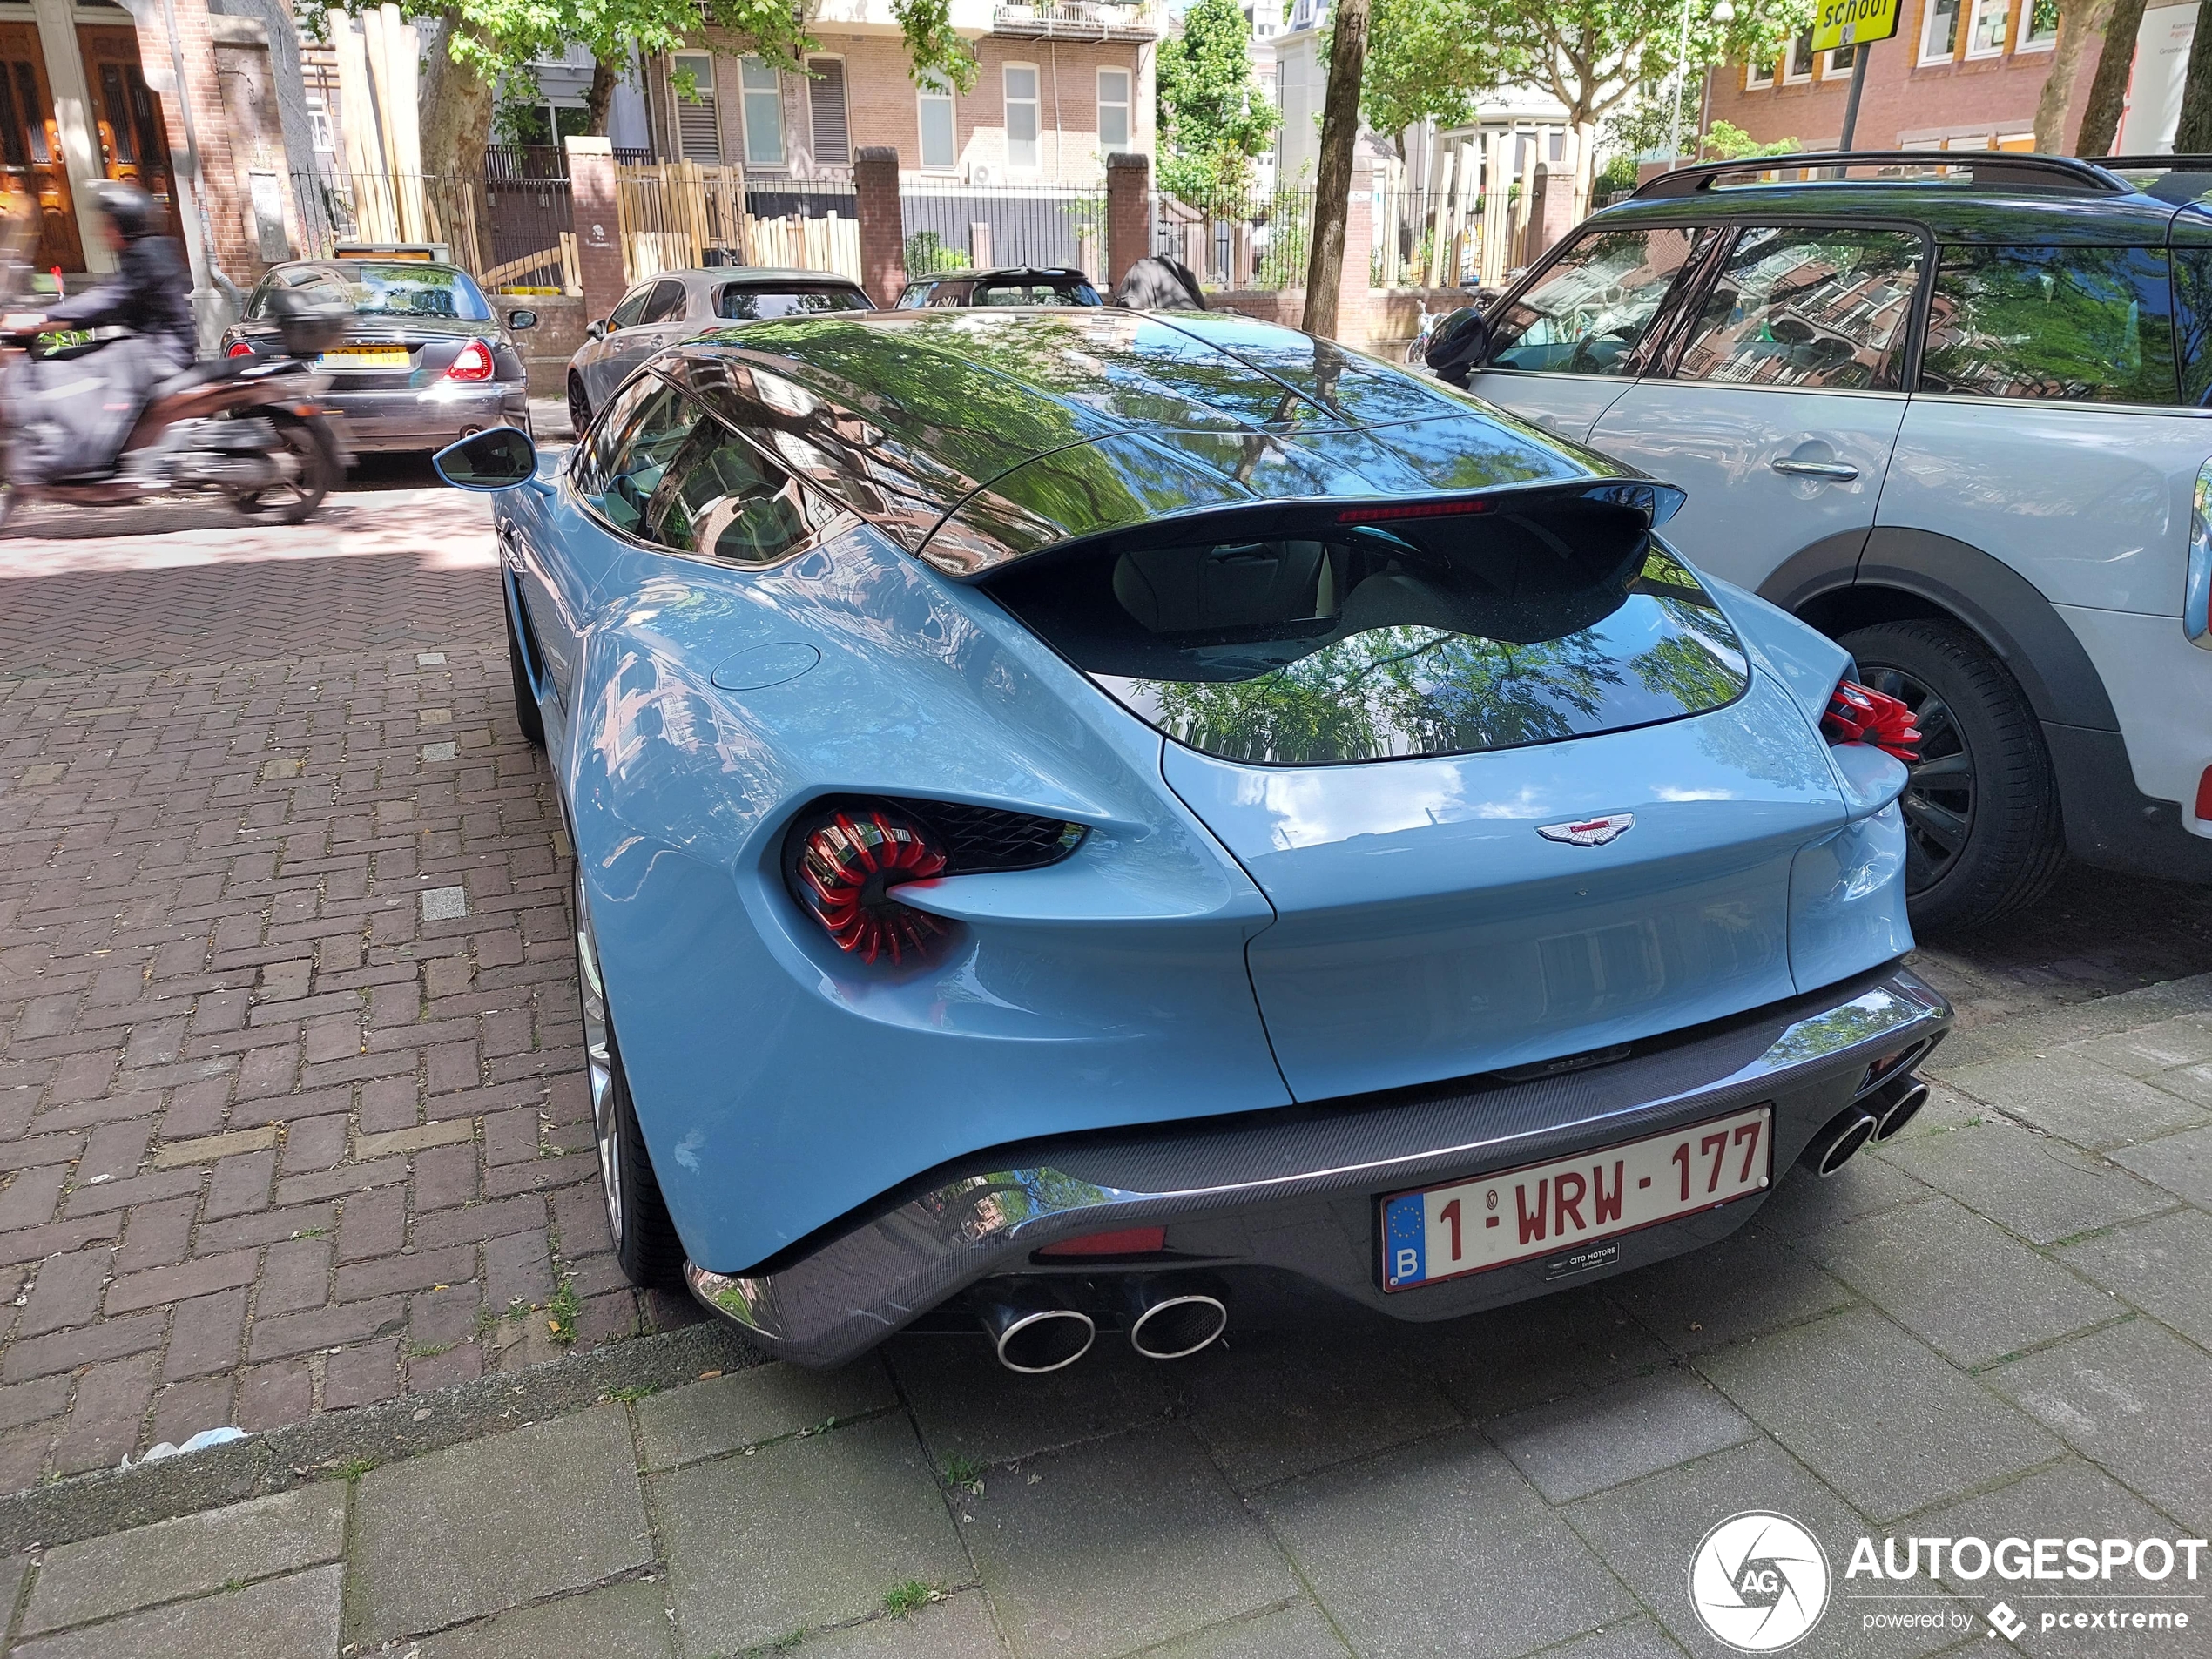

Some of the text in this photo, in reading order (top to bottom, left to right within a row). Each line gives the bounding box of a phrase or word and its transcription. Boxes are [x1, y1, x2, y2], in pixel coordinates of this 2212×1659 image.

[1823, 0, 1887, 28] school
[1397, 1248, 1418, 1278] B
[1569, 1246, 1615, 1264] CITO MOTORS
